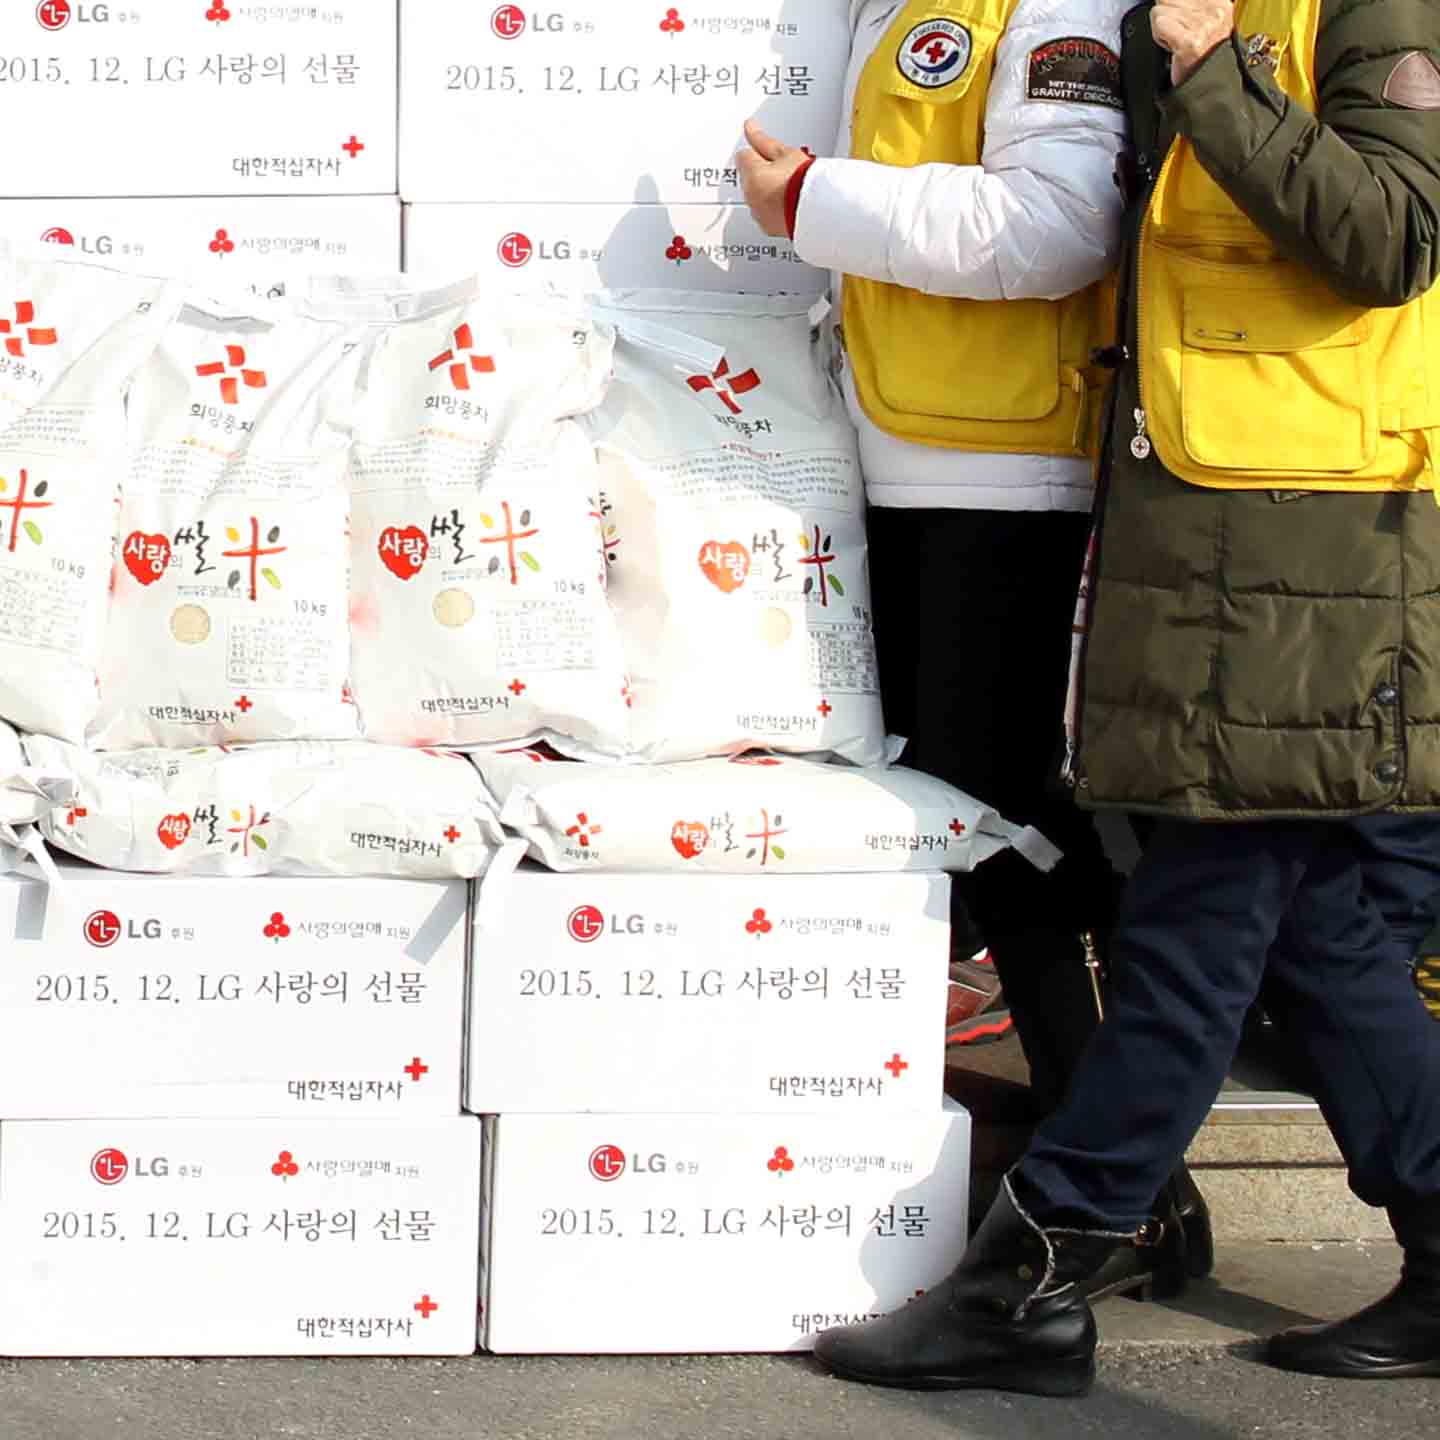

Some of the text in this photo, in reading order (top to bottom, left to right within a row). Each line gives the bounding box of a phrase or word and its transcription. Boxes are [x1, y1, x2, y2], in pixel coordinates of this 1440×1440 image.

[90, 57, 128, 84] 12.
[147, 57, 186, 81] LG
[200, 53, 285, 85] 사랑의
[304, 53, 360, 84] 선물
[448, 64, 814, 96] 2015. 12. LG 사랑의 선물
[1049, 80, 1065, 89] HIT
[1032, 88, 1081, 99] GRAVITY
[233, 157, 341, 176] 대한적십자사
[424, 395, 488, 422] 희망풍차
[174, 520, 216, 575] 쌀
[752, 529, 792, 582] 쌀
[149, 706, 236, 725] 대한적십자사
[194, 804, 222, 844] 쌀
[351, 832, 442, 857] 대한적십자사
[866, 834, 950, 851] 대한적십자사
[36, 971, 426, 1004] 2015. 12. LG 사랑의 선물
[520, 968, 905, 1000] 2015. 12. LG 사랑의 선물
[44, 1209, 436, 1242] 2015. 12. LG 사랑의 선물
